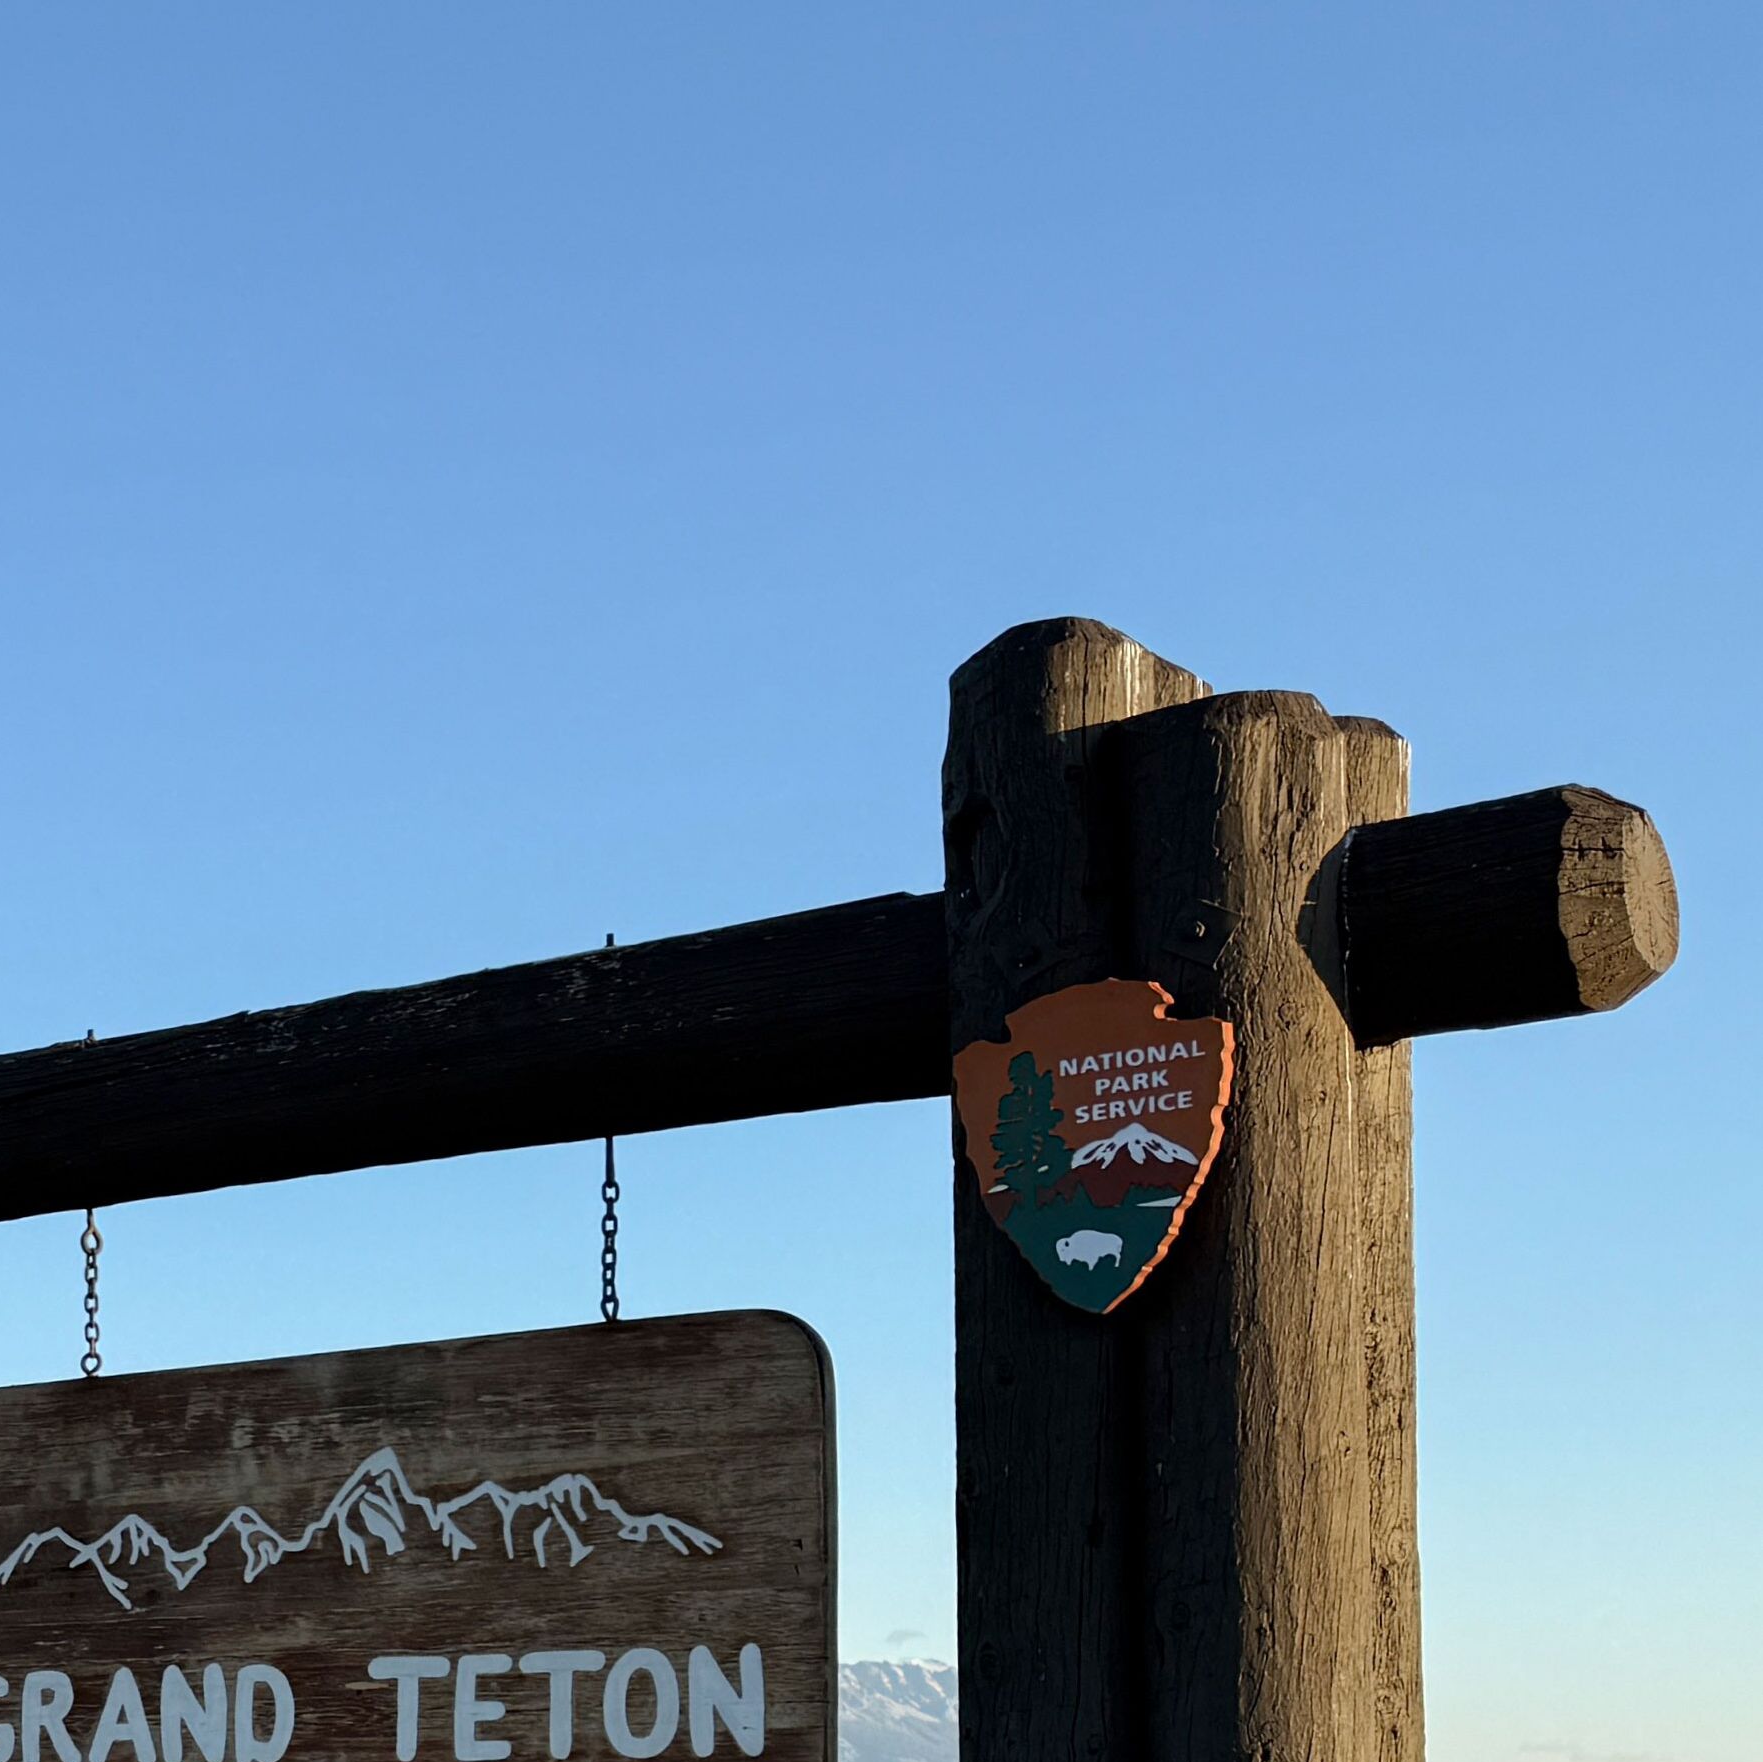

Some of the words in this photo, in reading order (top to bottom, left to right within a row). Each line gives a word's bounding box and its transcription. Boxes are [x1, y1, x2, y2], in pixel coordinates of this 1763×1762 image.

[1059, 1040, 1205, 1076] NATIONAL
[1095, 1069, 1169, 1095] PARK
[1075, 1091, 1193, 1123] SERVICE
[367, 1643, 766, 1762] TETON
